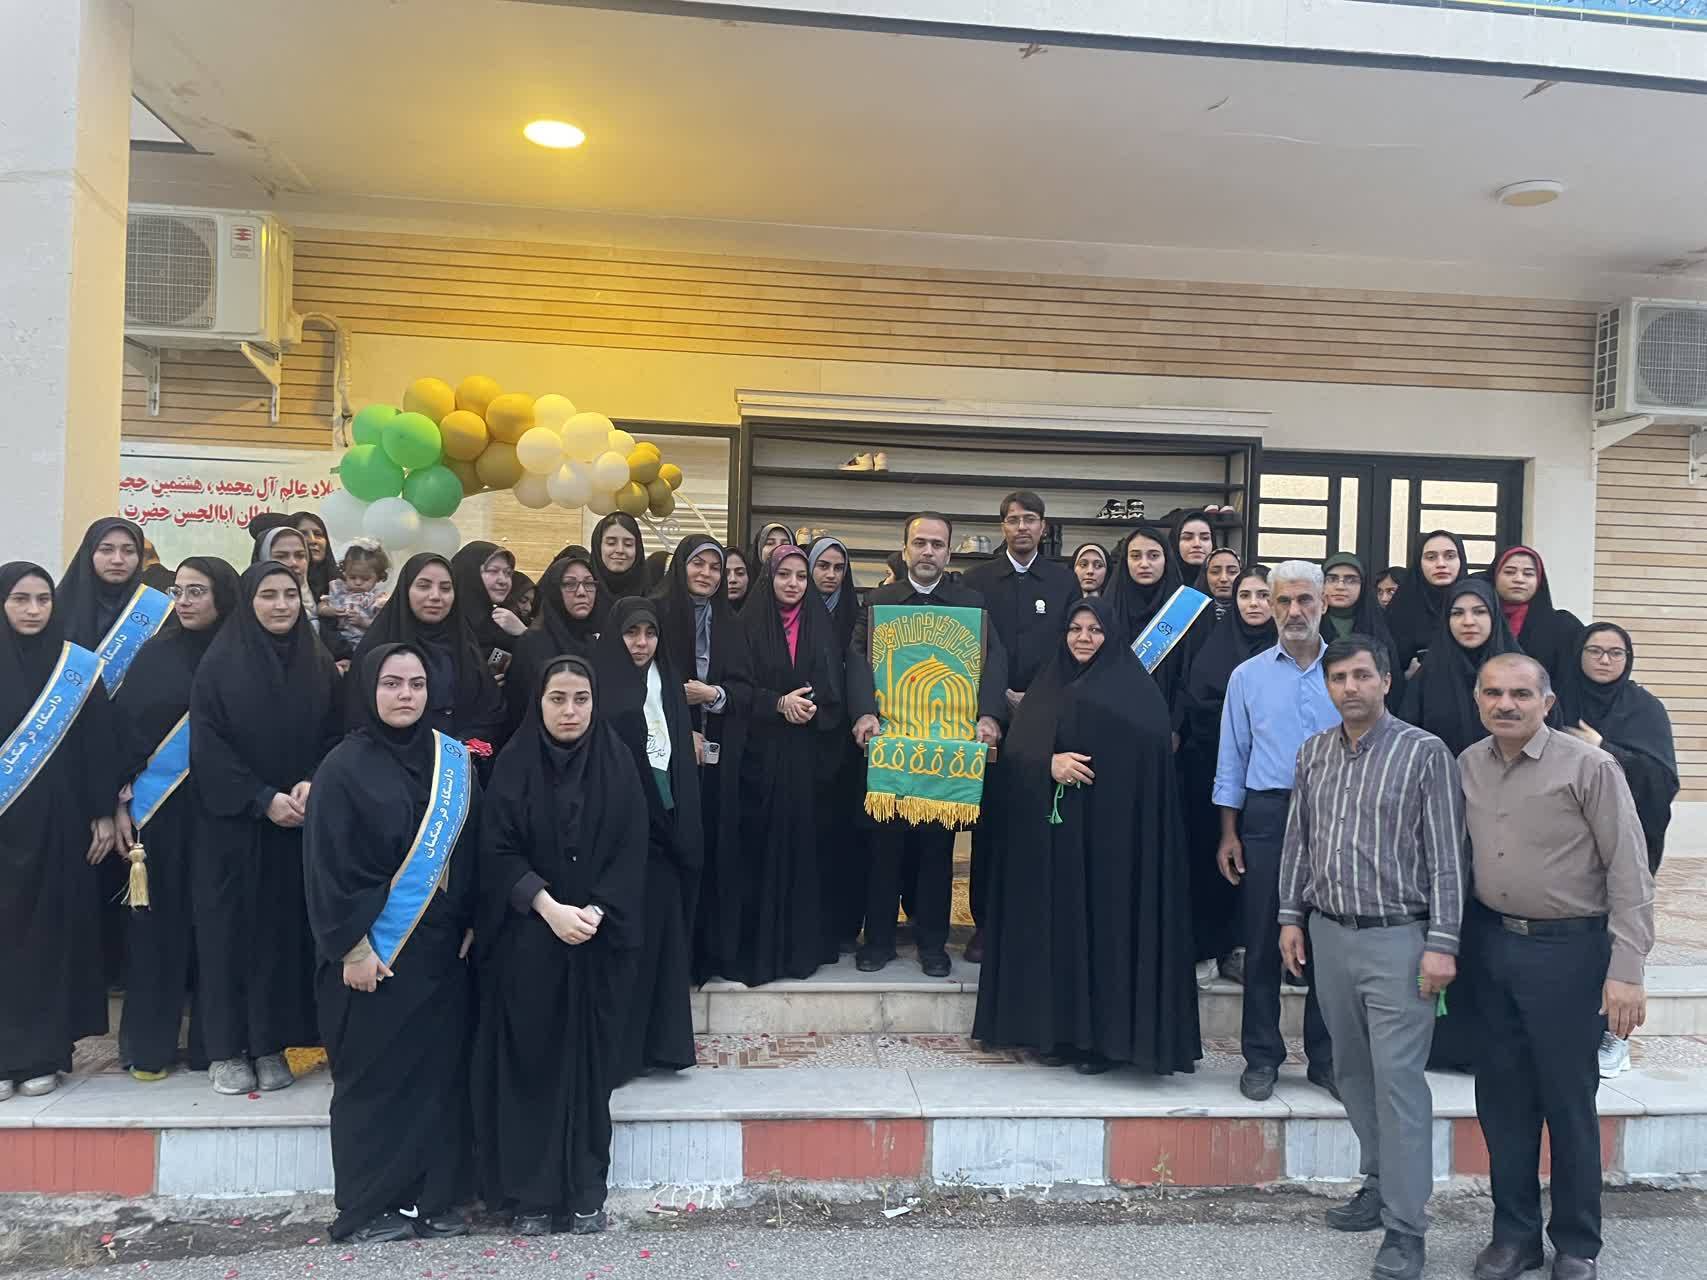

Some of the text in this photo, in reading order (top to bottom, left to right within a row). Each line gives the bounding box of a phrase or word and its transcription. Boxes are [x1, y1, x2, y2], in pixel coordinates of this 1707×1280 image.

[119, 476, 148, 496] حج
[151, 475, 203, 497] هشتمین
[256, 476, 277, 501] آل
[280, 478, 309, 502] عالم
[124, 502, 171, 525] حضرت
[441, 767, 455, 806] دانشگاه
